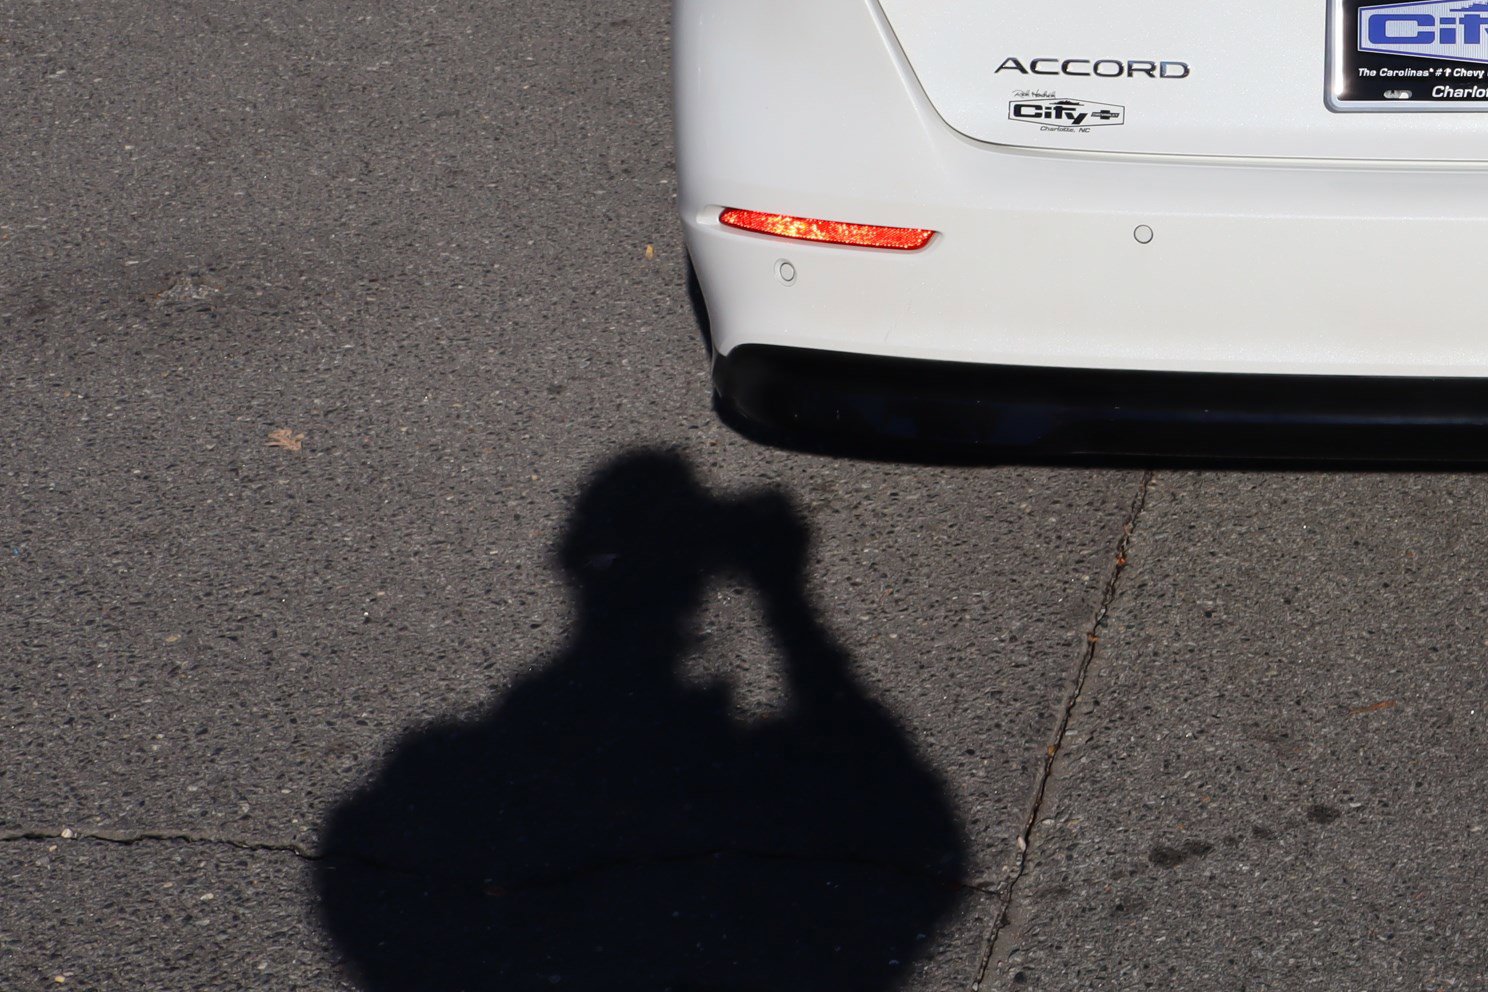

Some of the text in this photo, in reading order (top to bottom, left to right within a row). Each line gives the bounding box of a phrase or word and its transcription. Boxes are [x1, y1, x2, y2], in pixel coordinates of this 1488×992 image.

[994, 57, 1191, 79] ACCORD
[1358, 68, 1377, 77] The
[1453, 68, 1485, 79] Chevy
[1013, 103, 1088, 125] City
